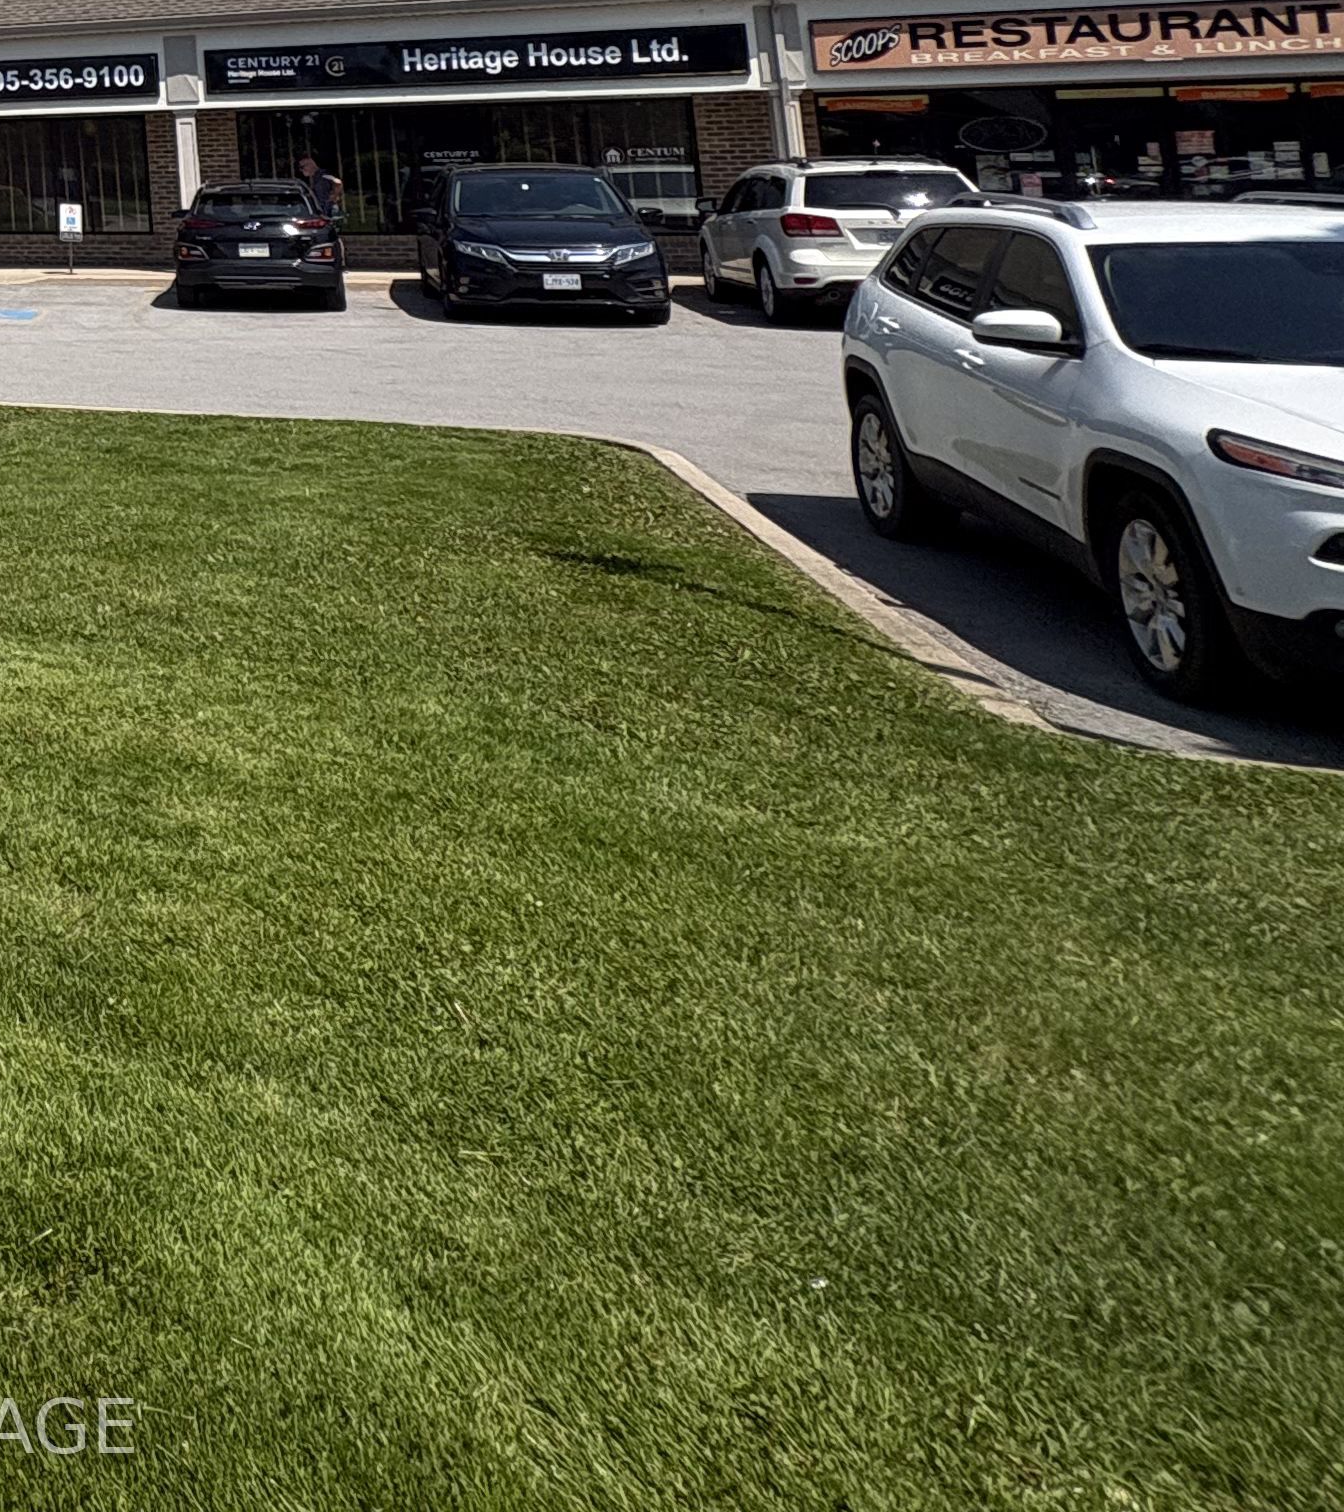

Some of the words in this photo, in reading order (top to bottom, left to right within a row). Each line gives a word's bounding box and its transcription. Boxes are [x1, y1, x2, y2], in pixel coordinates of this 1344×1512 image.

[907, 2, 1343, 50] RESTAURANT
[227, 55, 302, 69] CENTURY
[305, 54, 321, 66] 21
[402, 43, 520, 75] Heritage
[526, 40, 622, 68] House
[631, 36, 690, 64] Ltd.
[828, 24, 902, 67] SCOOPS
[910, 44, 1134, 65] BREAKFAST
[1151, 43, 1173, 57] &
[1194, 36, 1344, 54] LUNCH
[626, 146, 685, 157] CENTUM
